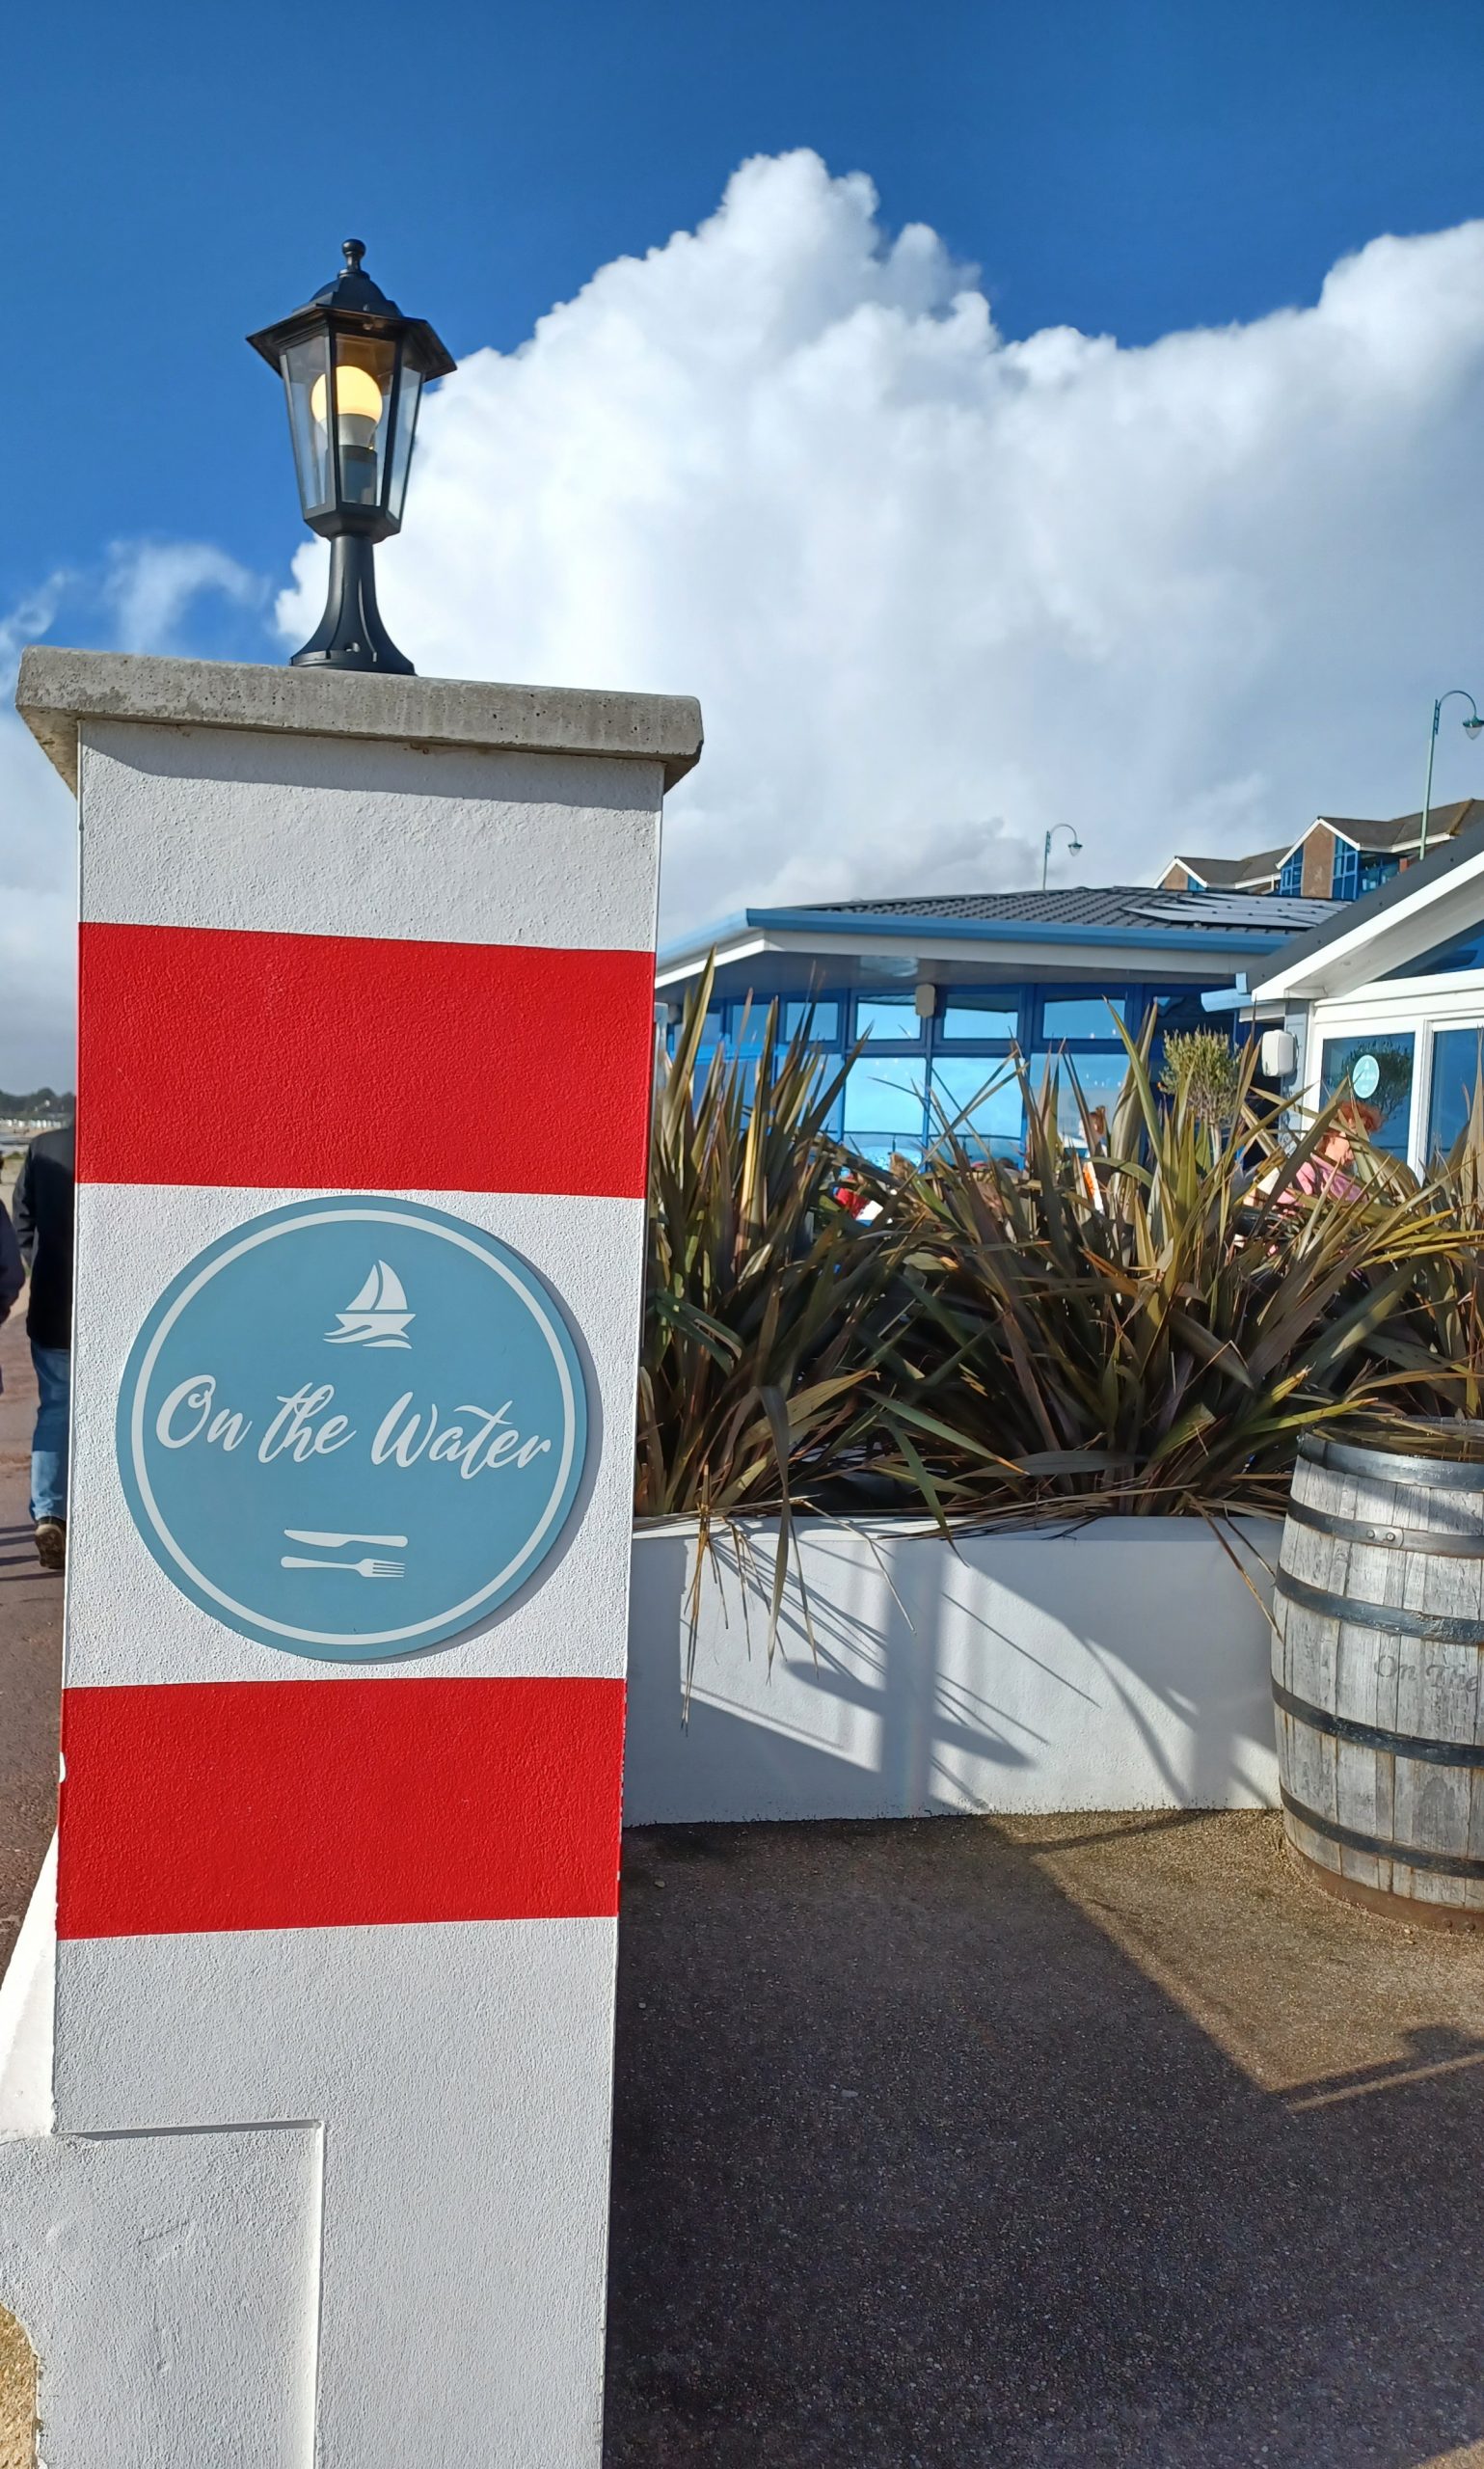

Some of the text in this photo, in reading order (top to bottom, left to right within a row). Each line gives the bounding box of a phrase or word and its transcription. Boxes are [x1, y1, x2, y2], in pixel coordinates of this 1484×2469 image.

[155, 1374, 552, 1480] On the Water
[1373, 1654, 1417, 1681] On
